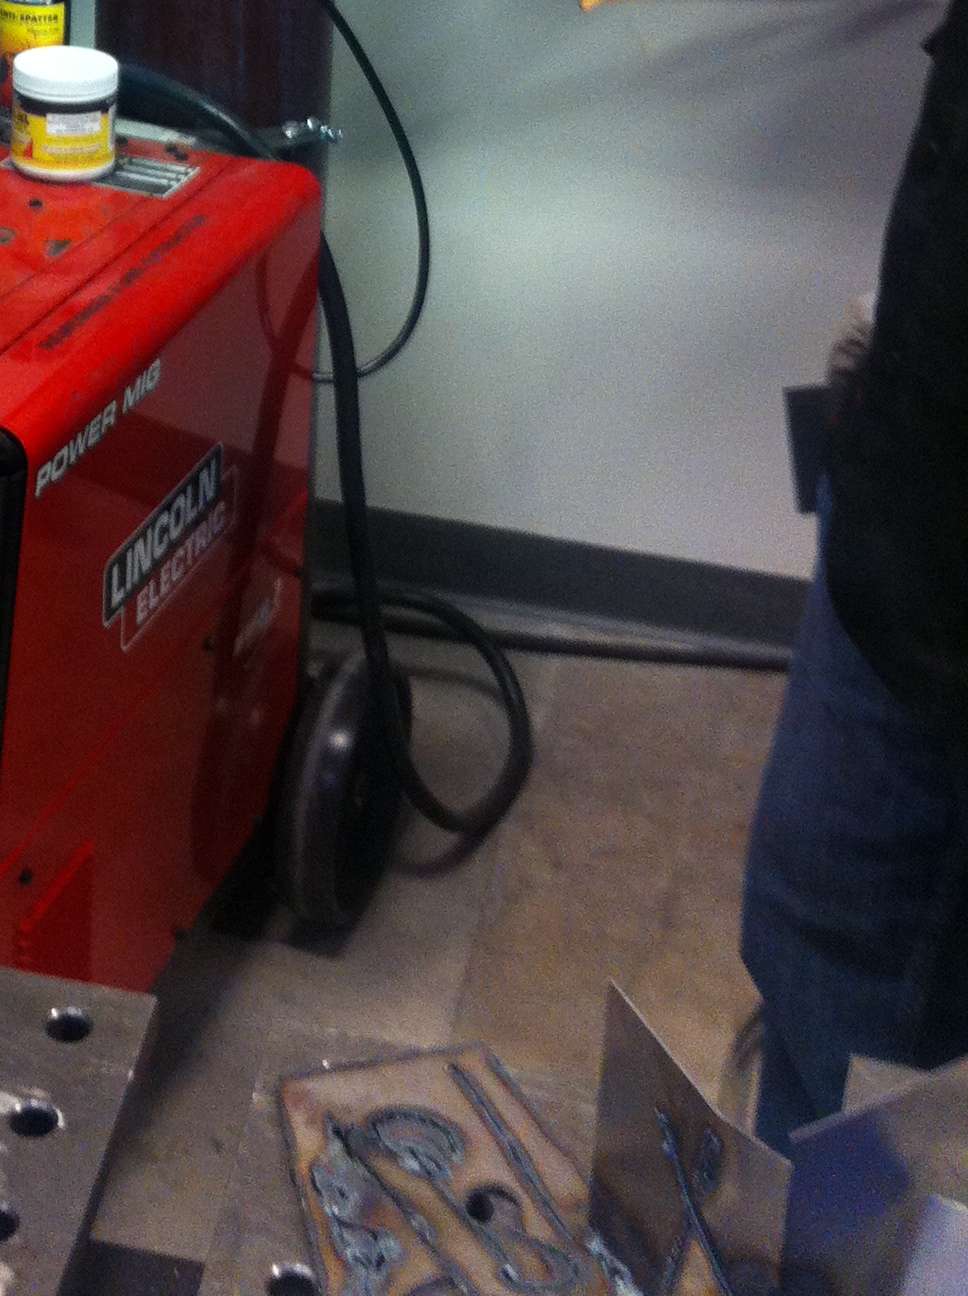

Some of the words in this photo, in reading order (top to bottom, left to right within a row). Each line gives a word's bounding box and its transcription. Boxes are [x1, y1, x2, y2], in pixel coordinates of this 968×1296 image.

[36, 400, 117, 499] POWER
[122, 357, 162, 414] MIG
[110, 459, 218, 607] LINCOLN
[136, 501, 226, 624] ELECTRIC
